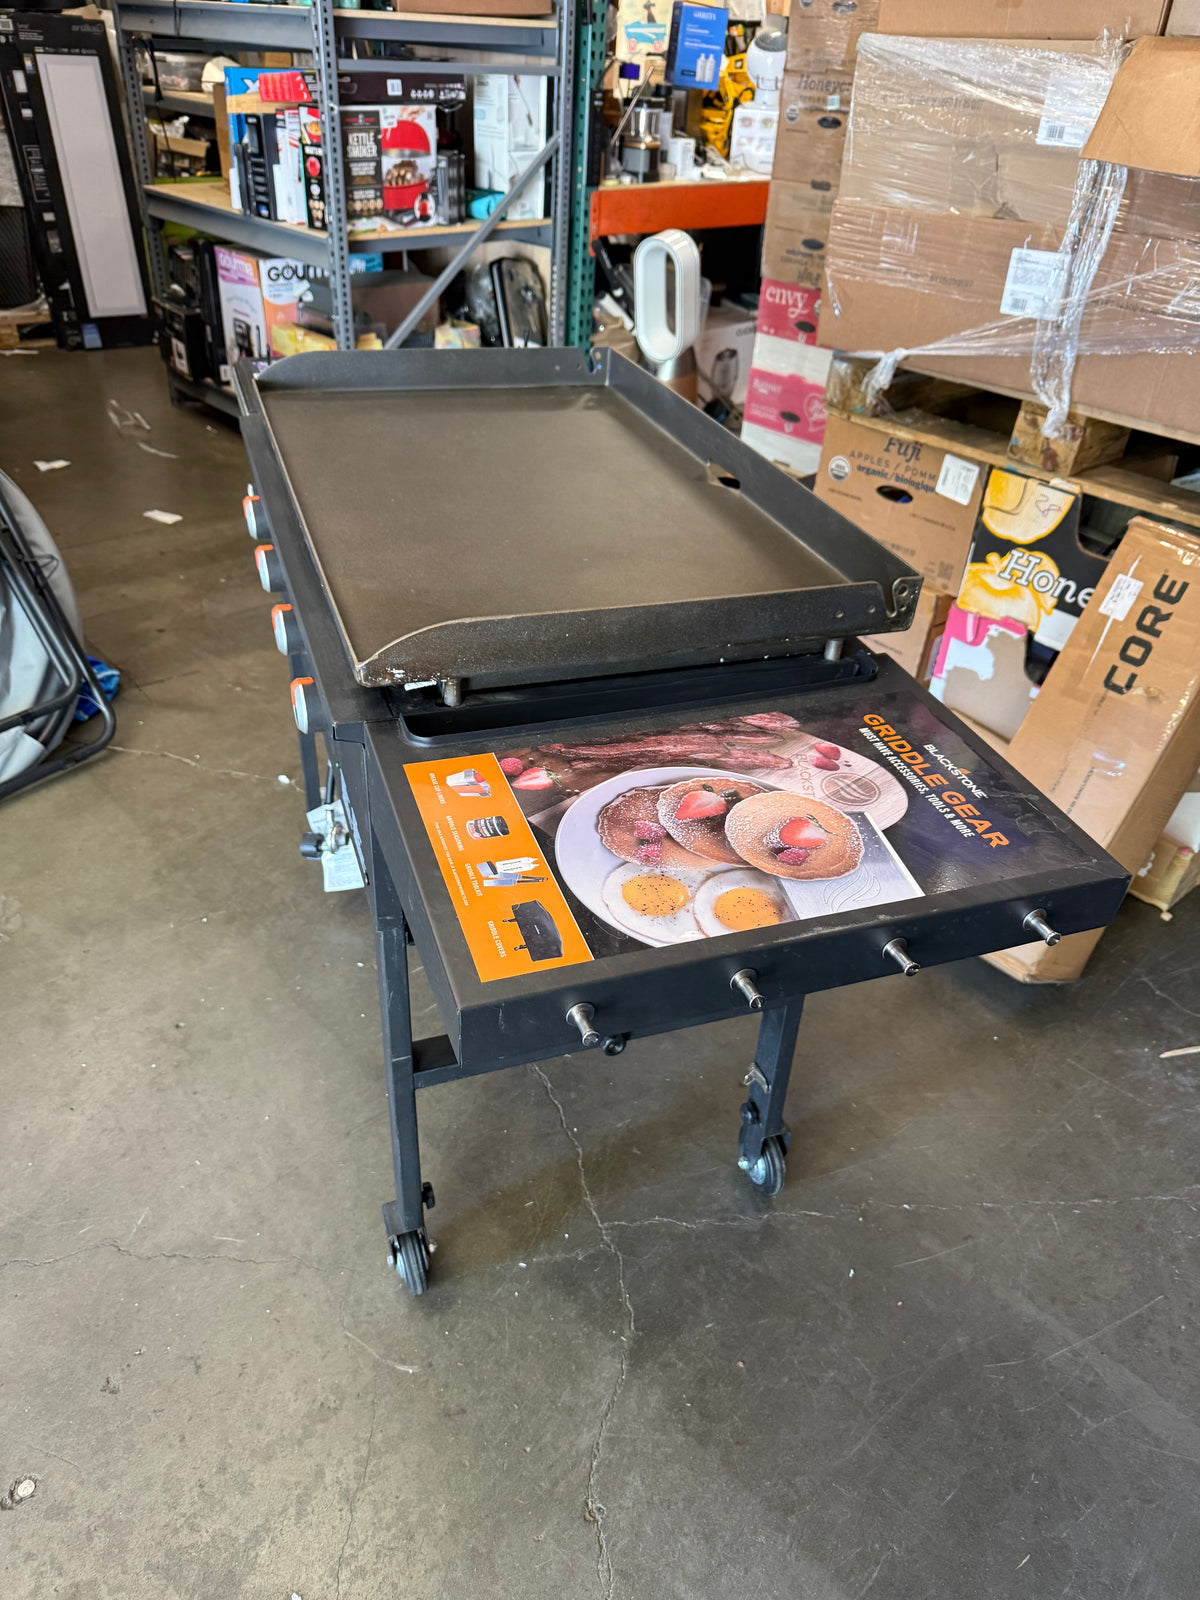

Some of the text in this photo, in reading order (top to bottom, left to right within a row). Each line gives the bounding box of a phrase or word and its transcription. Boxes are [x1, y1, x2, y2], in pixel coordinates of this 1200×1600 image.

[797, 73, 852, 95] Honeyc
[347, 131, 376, 146] KETTLE
[765, 285, 809, 318] envy
[849, 450, 890, 468] APPLES
[904, 465, 937, 482] POMM
[884, 436, 923, 463] Fuji
[998, 549, 1095, 608] Hone
[1103, 573, 1190, 695] CORE
[796, 754, 816, 798] BLACKST
[858, 727, 880, 742] MUST
[874, 739, 892, 757] HAVE
[925, 793, 950, 814] TOOLS
[949, 819, 976, 838] MORE
[863, 714, 1010, 848] GRIDDLE GEAR
[923, 743, 986, 799] BLACKSTONE
